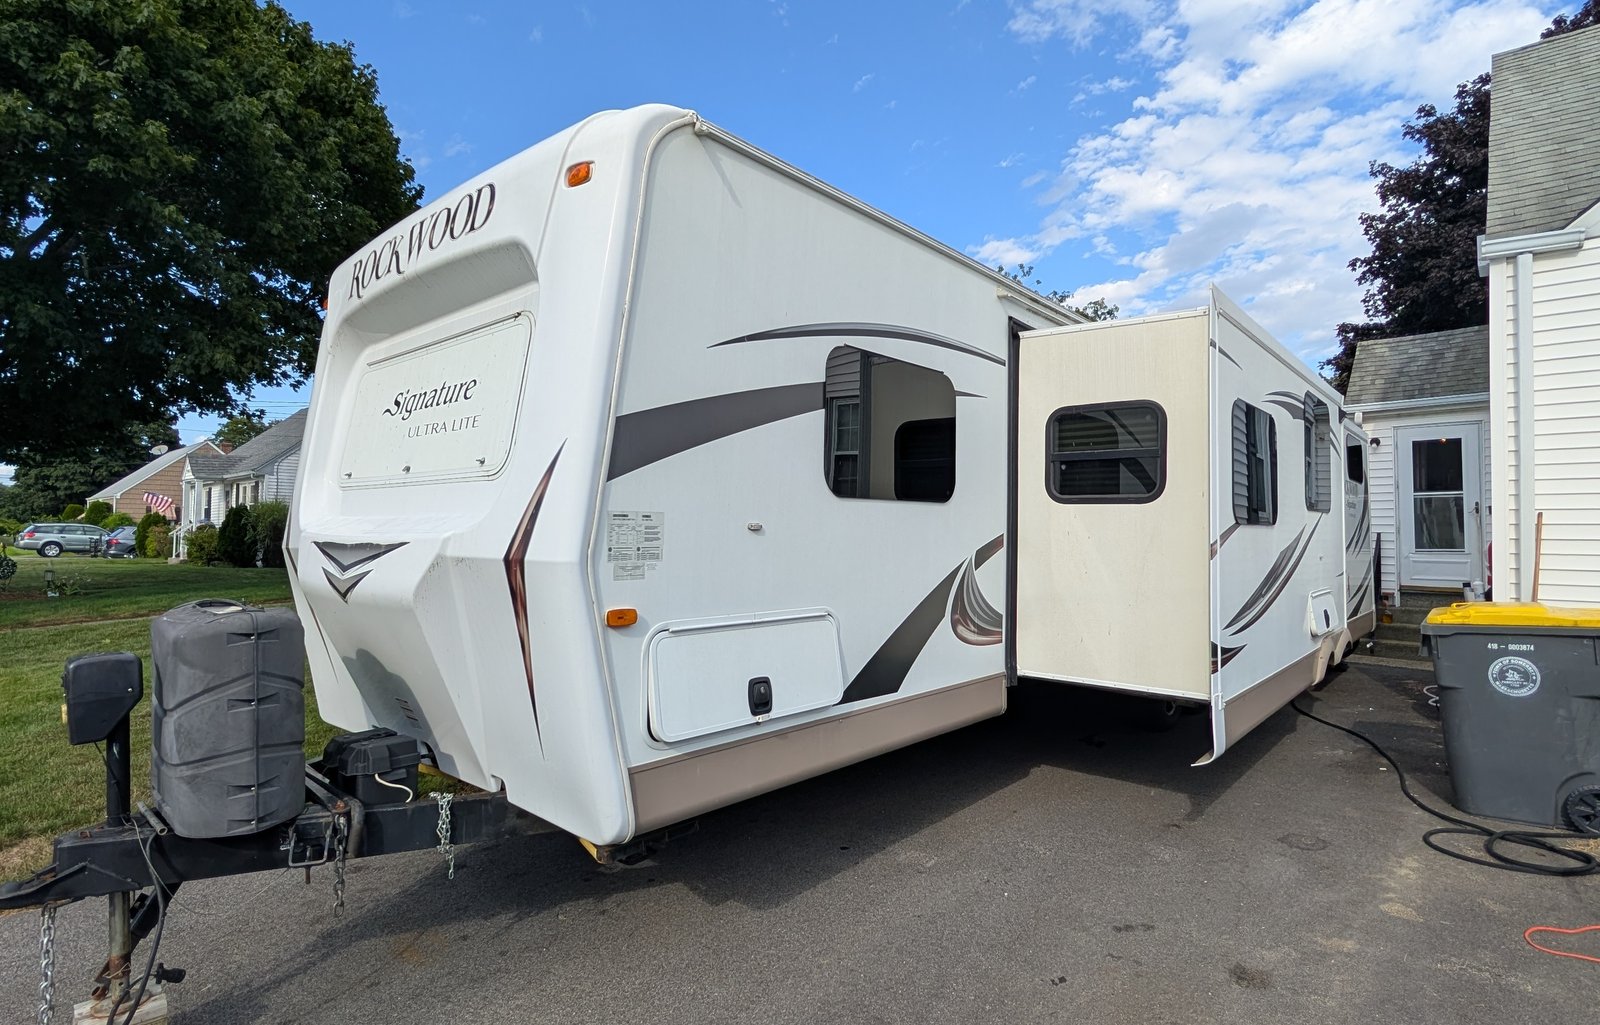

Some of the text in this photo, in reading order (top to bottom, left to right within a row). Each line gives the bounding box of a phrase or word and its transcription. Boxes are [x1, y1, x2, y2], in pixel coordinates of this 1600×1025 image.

[348, 182, 496, 301] ROCKWOOD
[382, 379, 477, 421] Signature
[408, 414, 481, 438] ULTRA LITE
